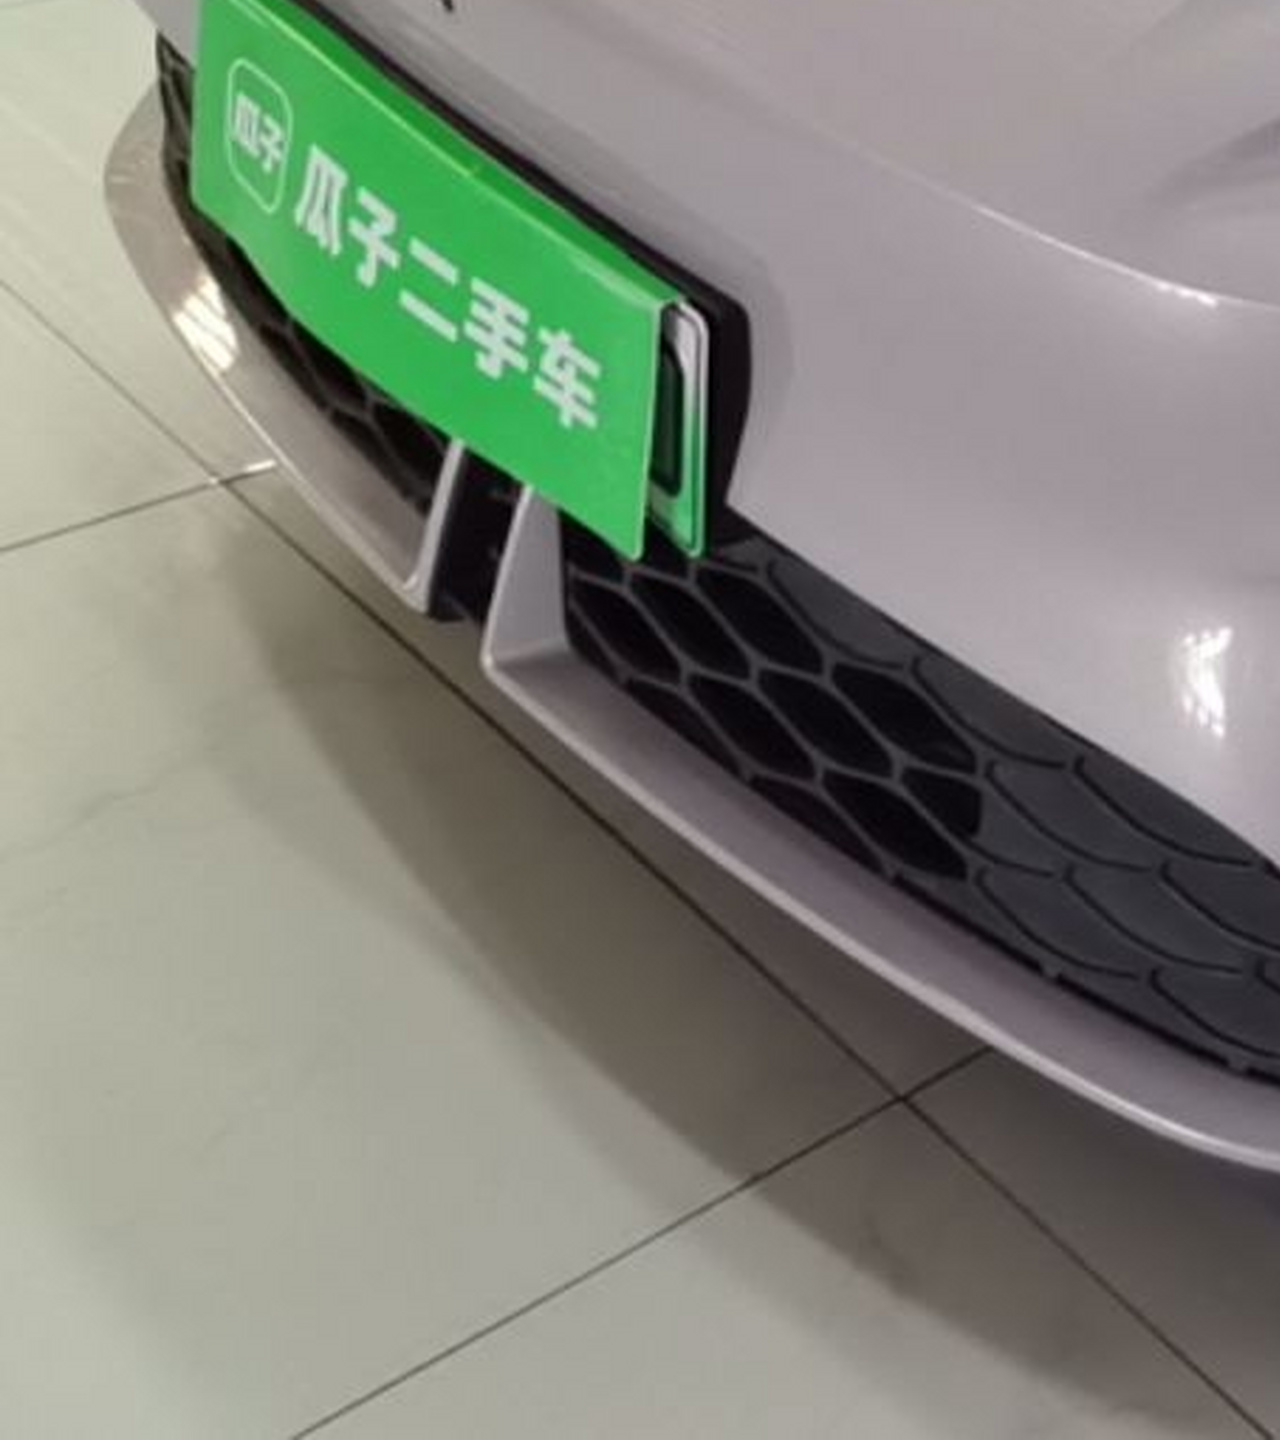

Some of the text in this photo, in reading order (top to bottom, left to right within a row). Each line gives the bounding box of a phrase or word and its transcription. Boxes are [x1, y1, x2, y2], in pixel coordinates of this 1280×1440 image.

[233, 92, 283, 173] 瓜子
[294, 143, 600, 429] 瓜子二手车
